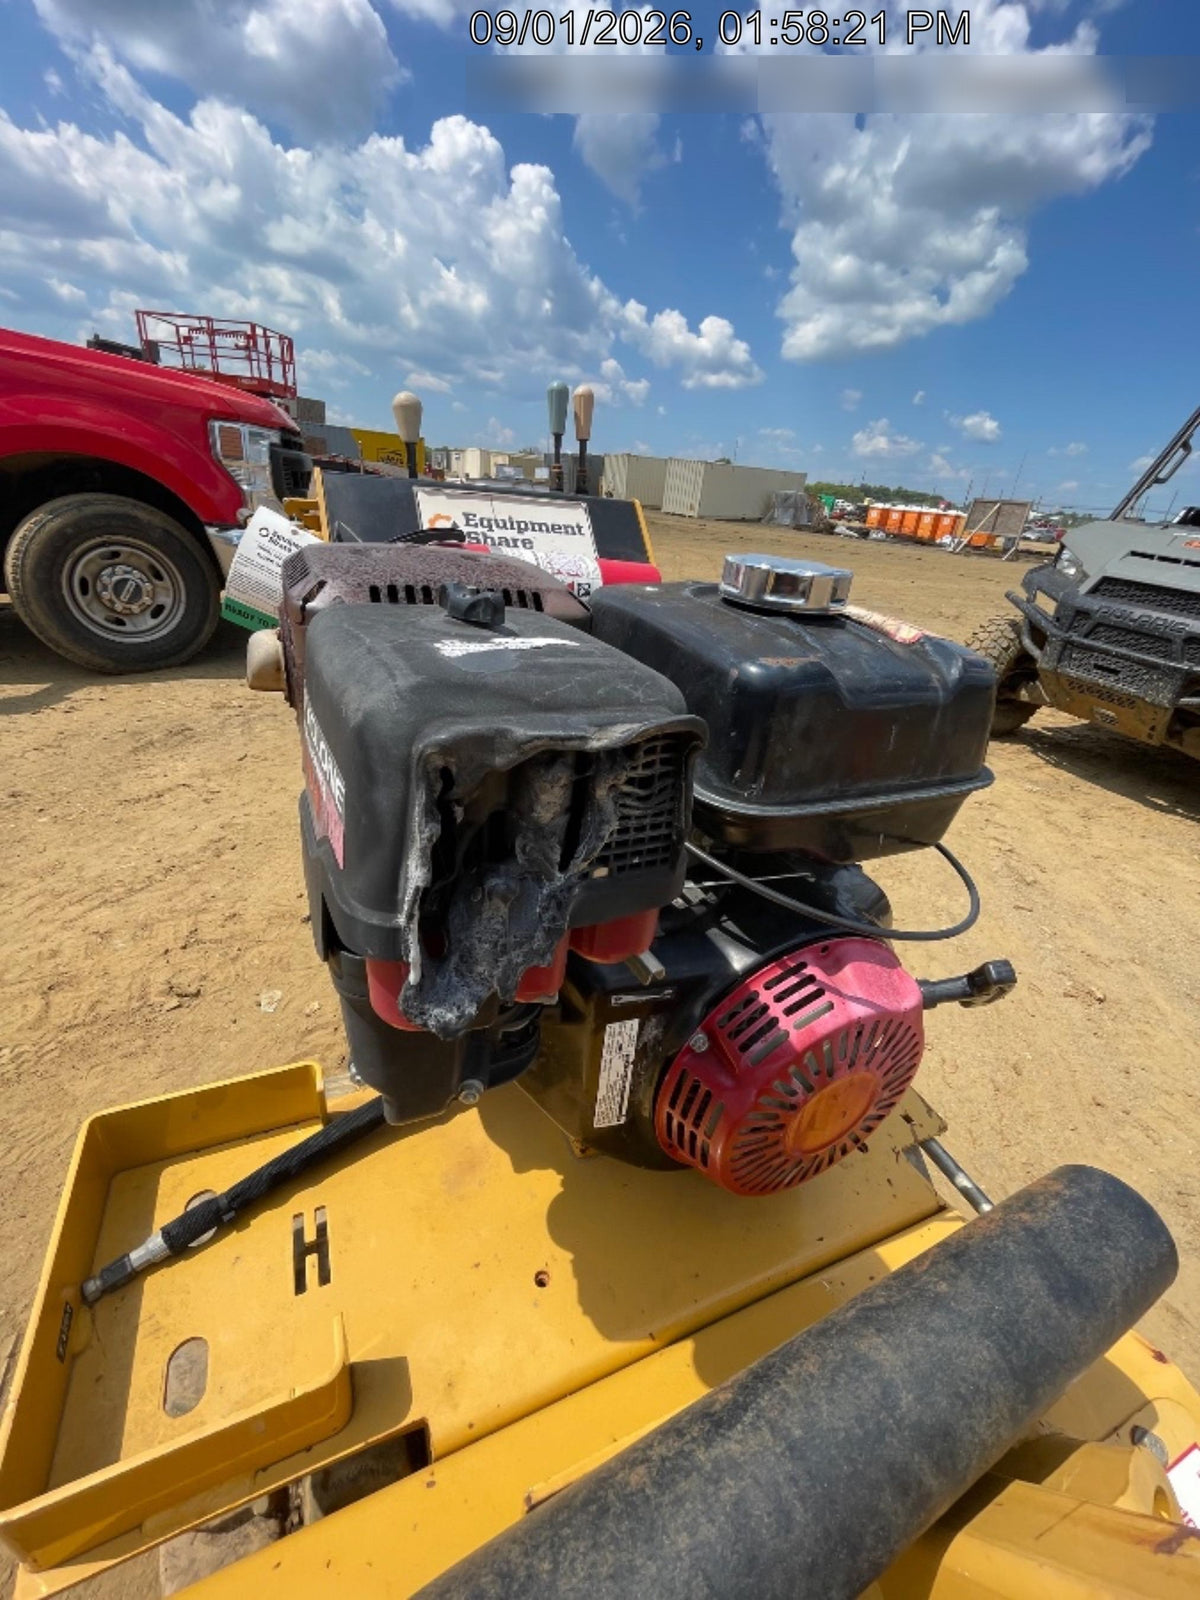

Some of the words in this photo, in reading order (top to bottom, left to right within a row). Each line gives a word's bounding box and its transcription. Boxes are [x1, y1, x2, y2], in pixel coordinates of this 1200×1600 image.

[462, 511, 585, 536] Equipment
[466, 531, 534, 550] Share
[1095, 605, 1191, 635] POLARIS
[292, 1204, 332, 1297] H
